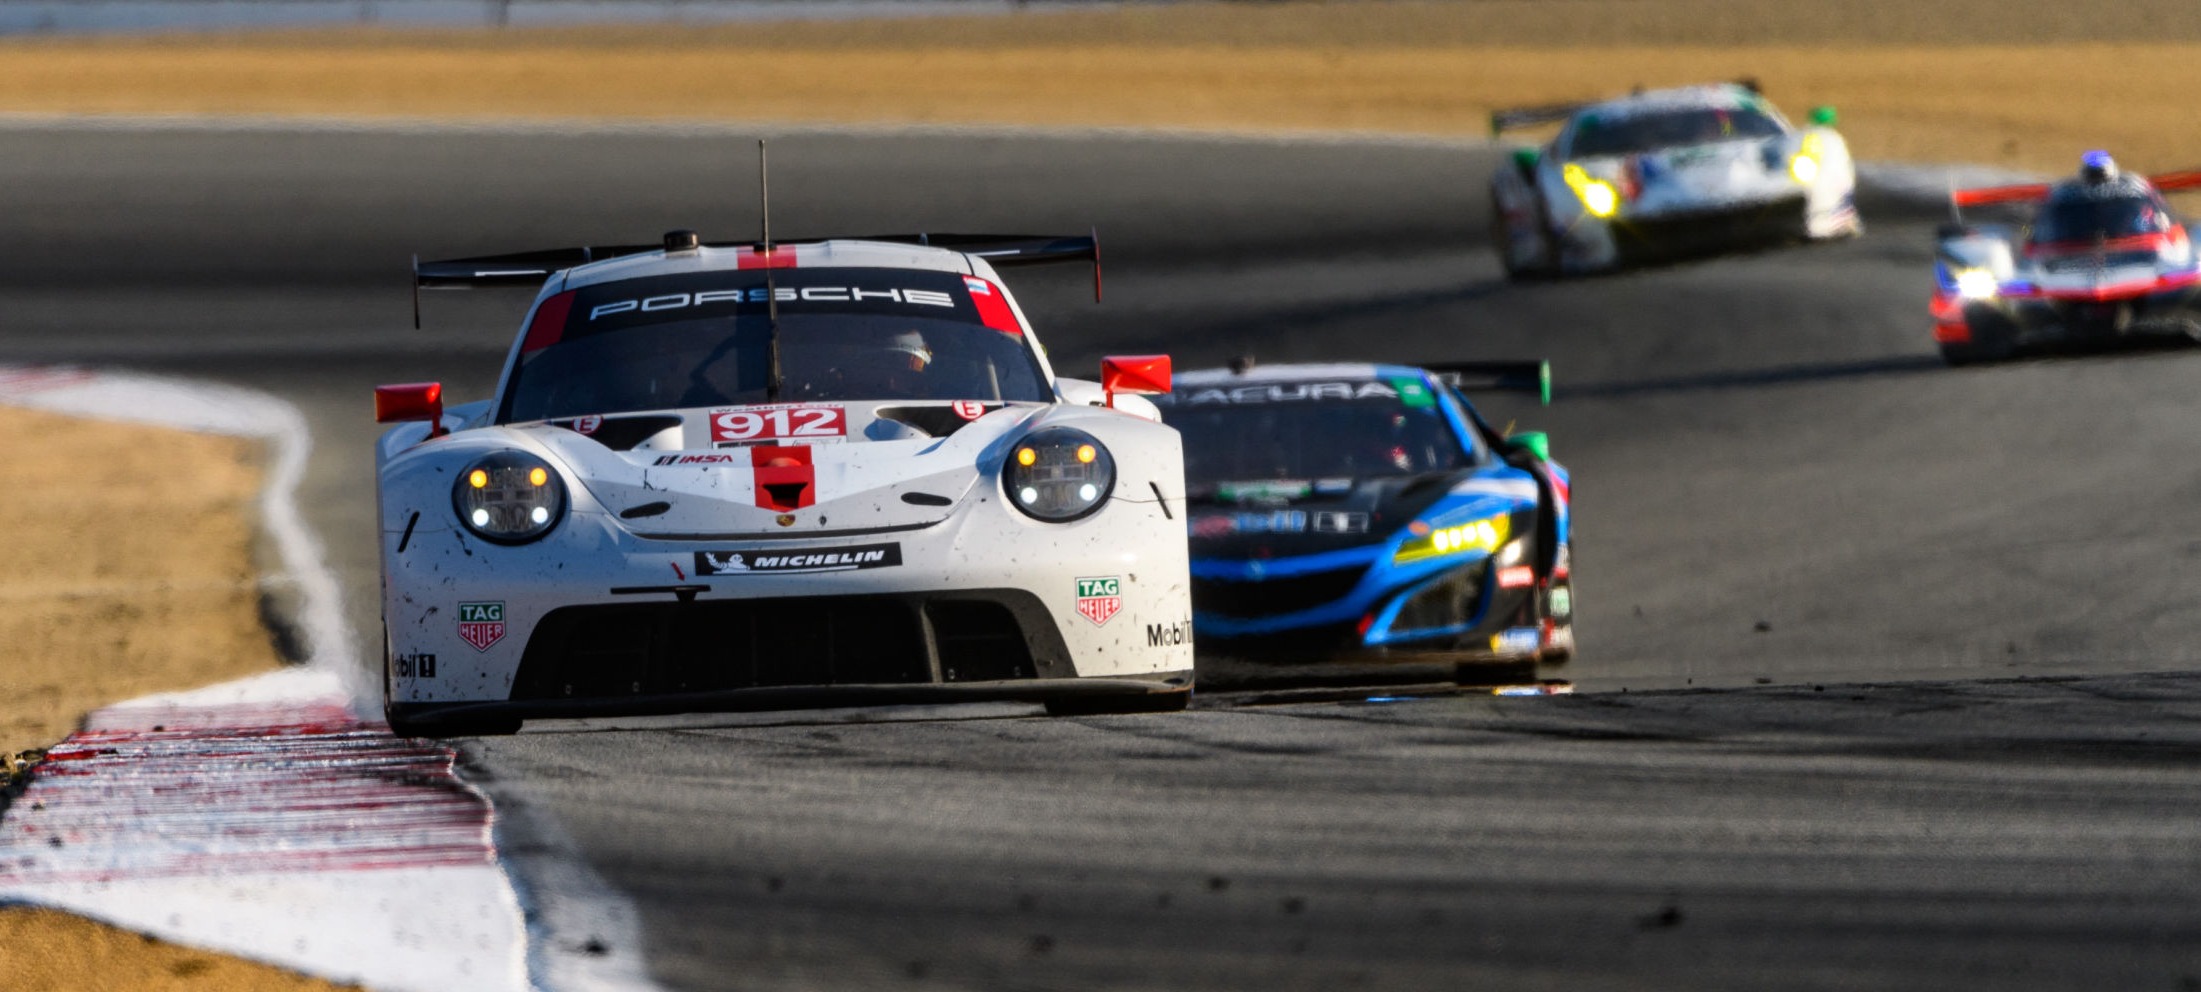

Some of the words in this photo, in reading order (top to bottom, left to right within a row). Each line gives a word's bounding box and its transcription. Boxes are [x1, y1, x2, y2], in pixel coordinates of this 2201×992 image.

[590, 287, 955, 321] PORSCHE
[1190, 382, 1398, 405] ACURA
[962, 400, 978, 416] E
[579, 416, 593, 431] E
[717, 408, 839, 439] 912
[678, 454, 734, 464] IMSA
[754, 550, 884, 567] MICHELIN
[1080, 580, 1118, 596] TAG
[462, 606, 500, 620] TAG
[1080, 599, 1119, 622] HEUER
[461, 624, 502, 647] HEUER
[393, 653, 416, 677] obil
